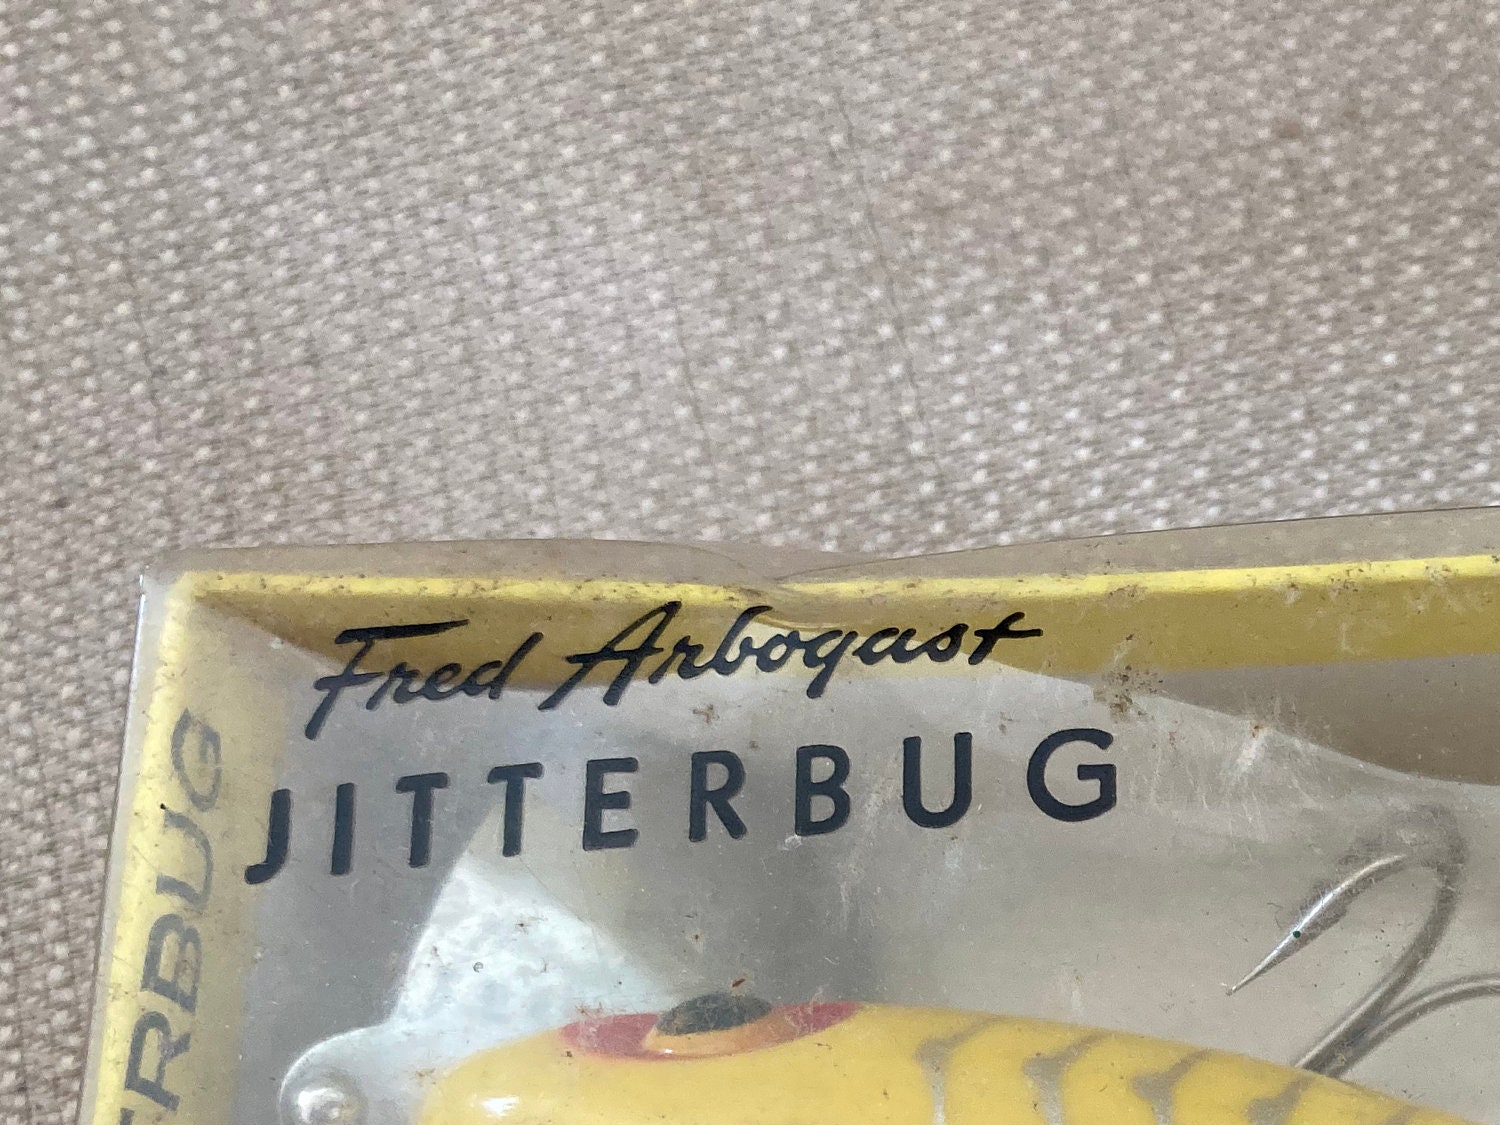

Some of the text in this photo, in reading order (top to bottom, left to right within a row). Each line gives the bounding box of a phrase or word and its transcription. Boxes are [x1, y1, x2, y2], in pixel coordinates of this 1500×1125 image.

[305, 601, 1044, 740] Fred Arbogast
[244, 727, 1118, 886] JITTERBUG
